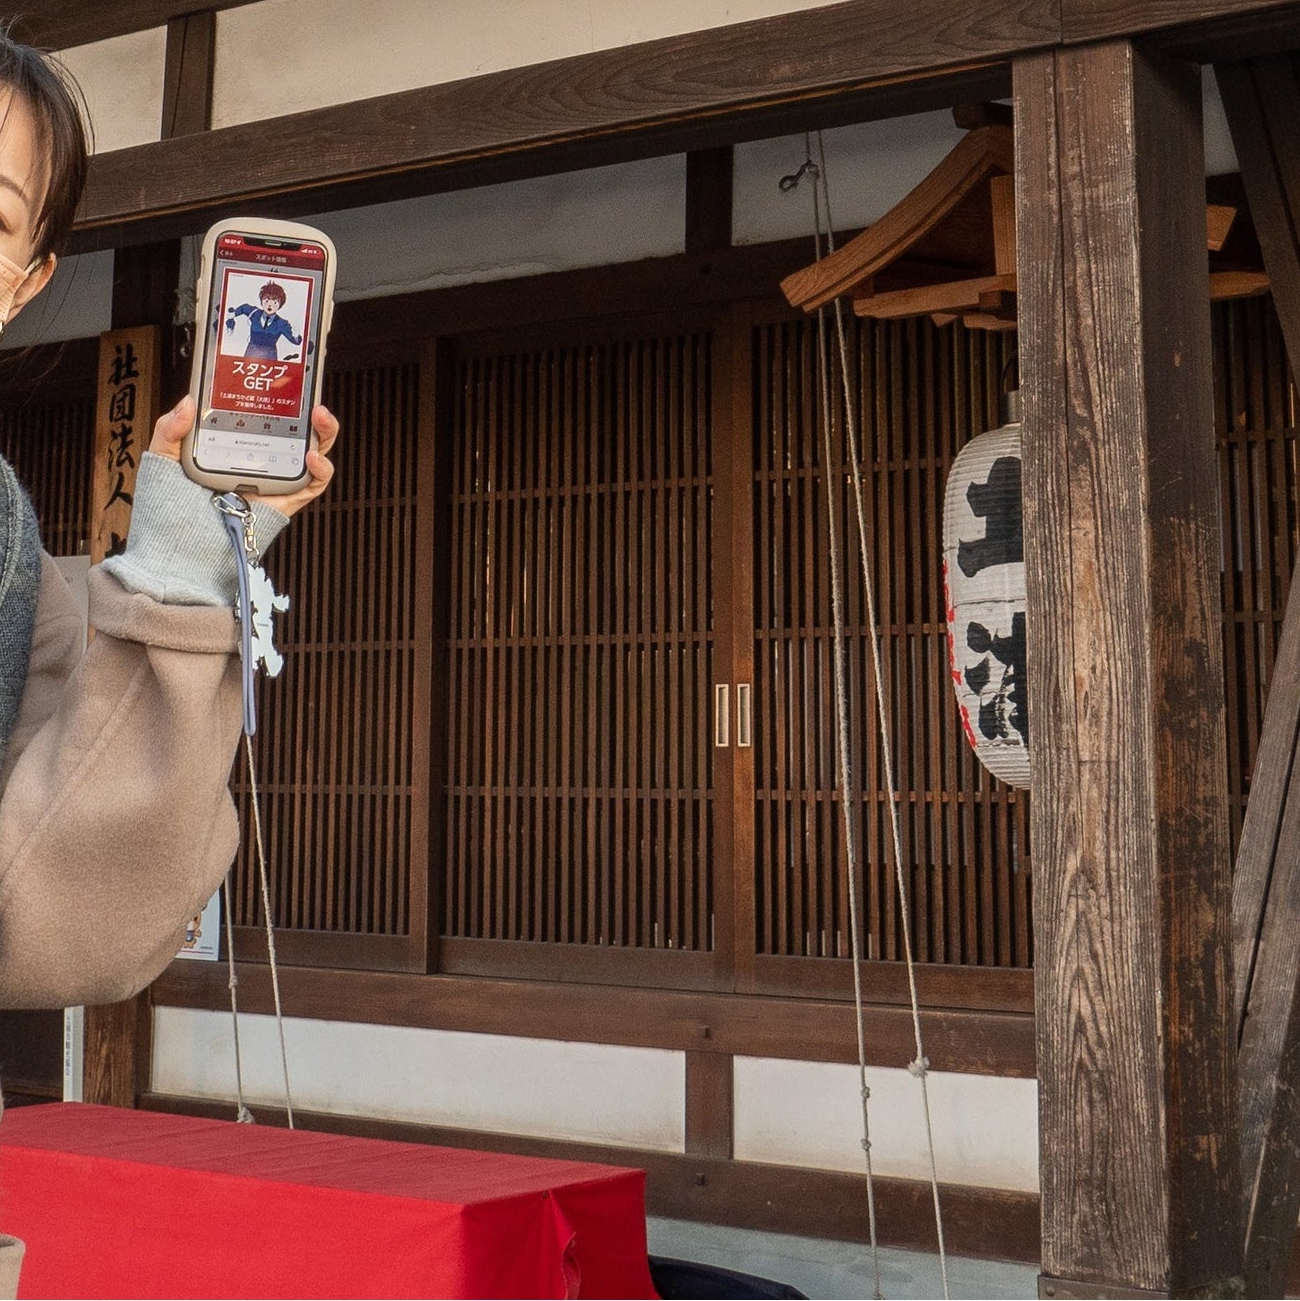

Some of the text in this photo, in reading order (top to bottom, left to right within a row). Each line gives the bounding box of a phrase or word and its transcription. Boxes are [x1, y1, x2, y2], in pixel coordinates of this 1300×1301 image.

[233, 361, 288, 378] スタンプ
[244, 376, 274, 391] GET
[104, 343, 139, 510] 社団法人
